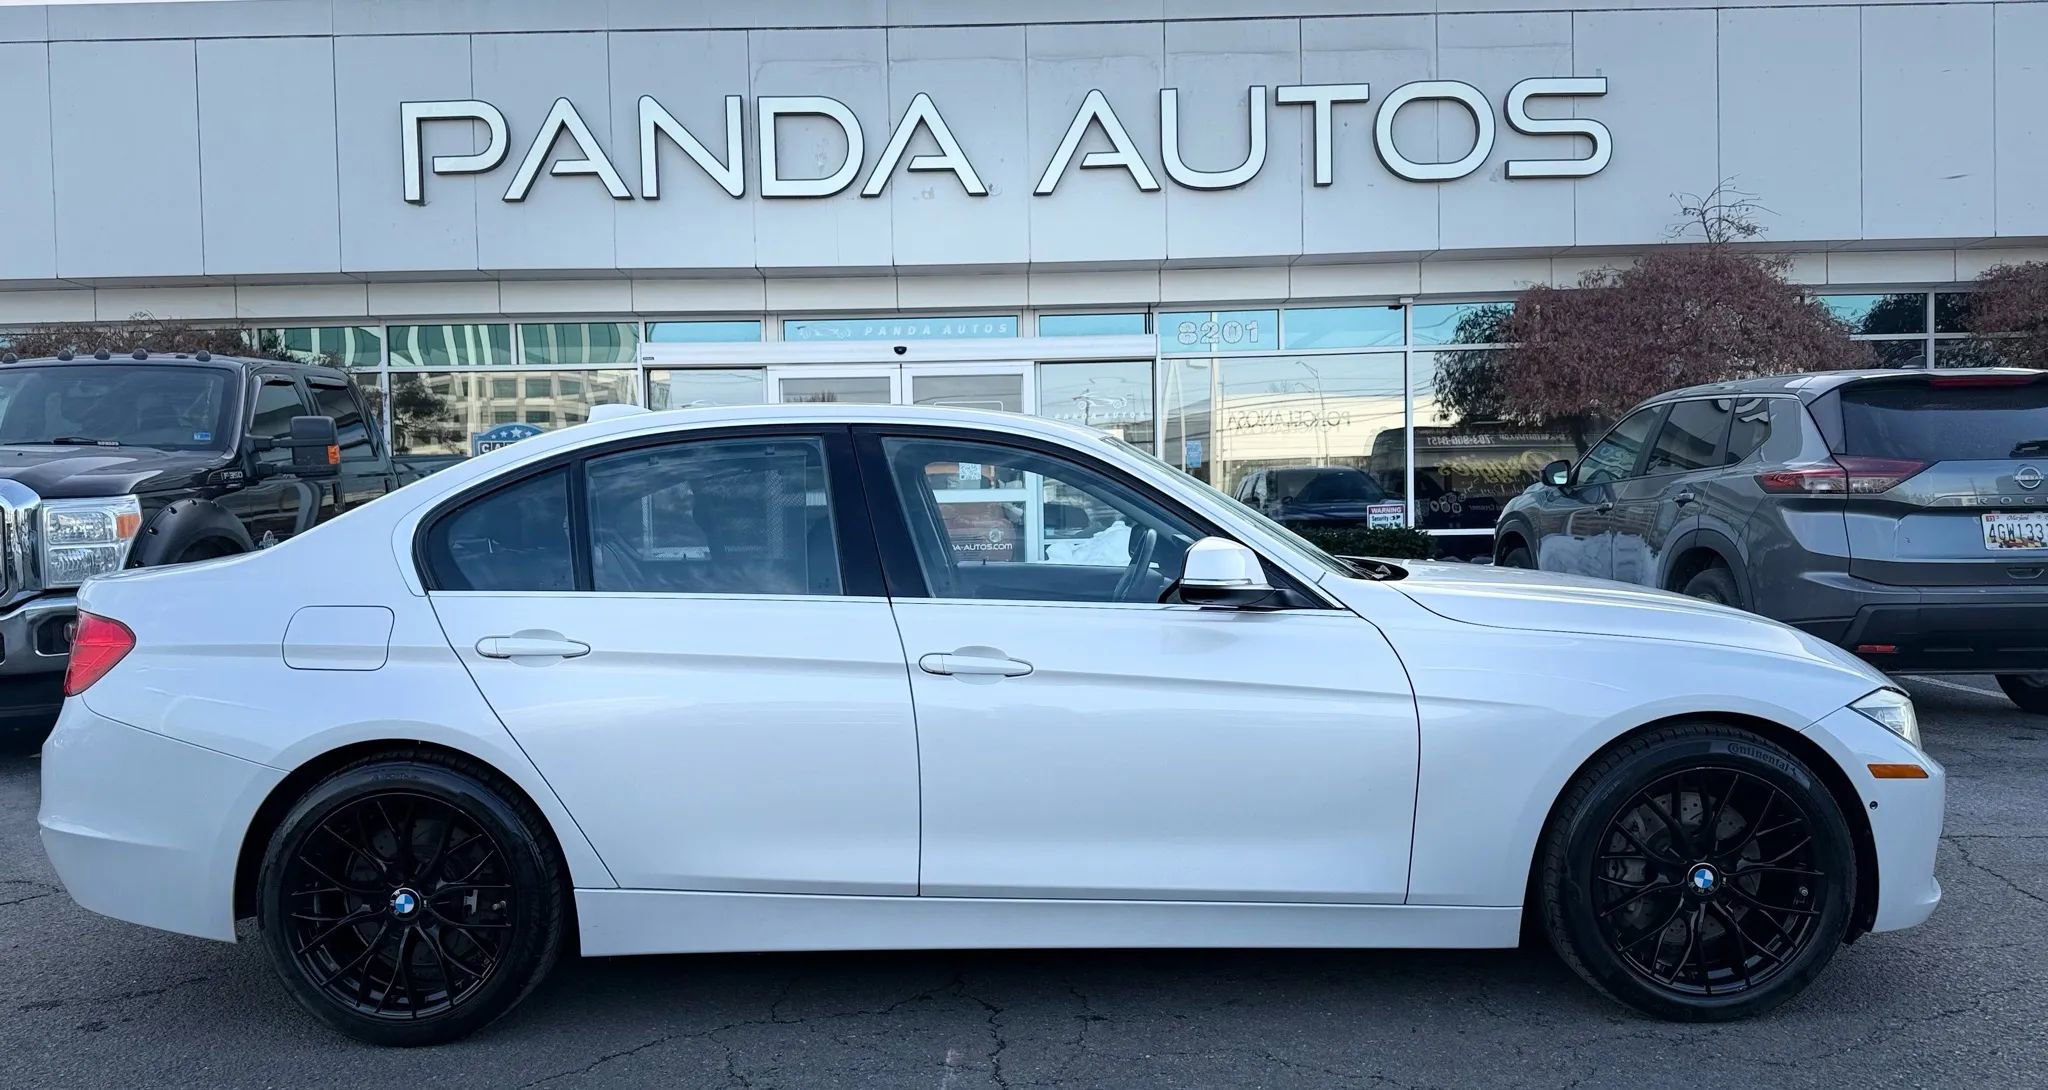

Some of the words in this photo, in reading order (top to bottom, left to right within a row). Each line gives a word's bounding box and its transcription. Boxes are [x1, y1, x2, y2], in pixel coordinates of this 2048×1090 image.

[400, 92, 989, 203] PANDA
[1033, 76, 1613, 196] AUTOS
[864, 324, 931, 336] PANDA
[943, 323, 1008, 335] AUTOS
[1177, 320, 1259, 345] 8201
[1371, 506, 1402, 514] WARNING
[1977, 496, 2048, 504] ROG
[1989, 523, 2048, 543] 4GW133
[1727, 742, 1790, 772] Continental
